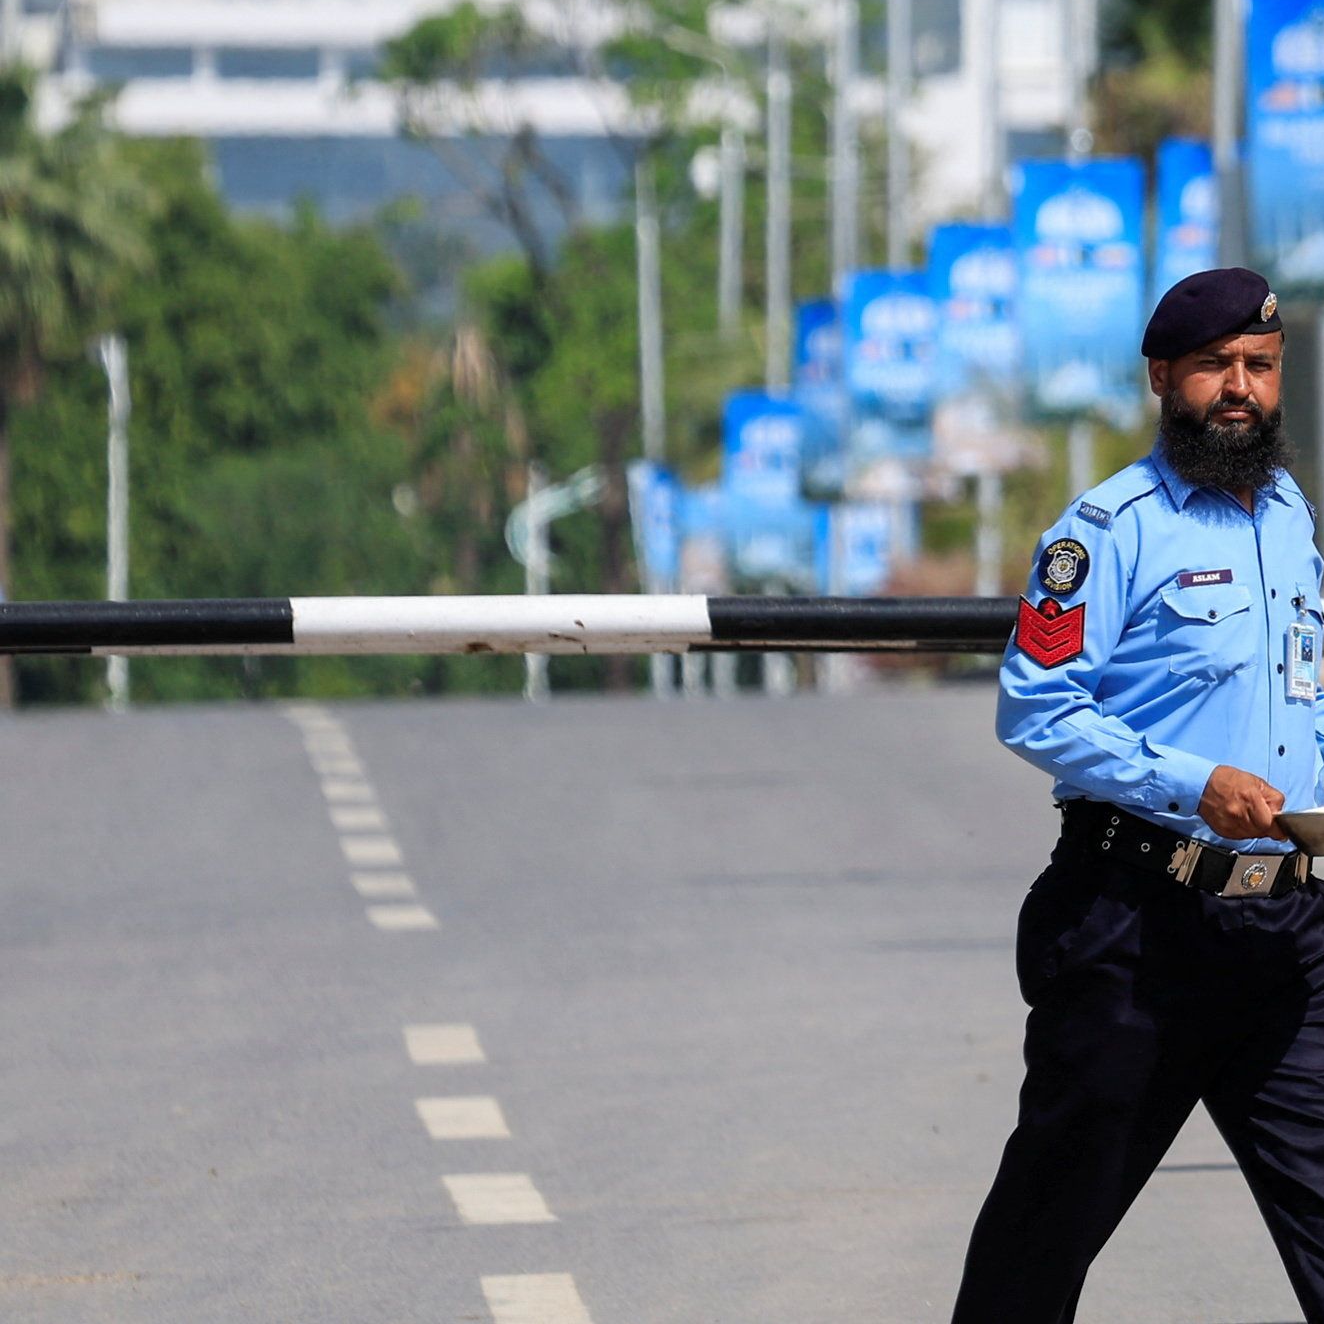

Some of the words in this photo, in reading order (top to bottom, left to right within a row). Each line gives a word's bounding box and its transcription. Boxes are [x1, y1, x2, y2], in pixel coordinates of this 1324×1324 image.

[1047, 540, 1086, 560] OPERATIONS
[1044, 577, 1073, 590] DIVISION
[1192, 573, 1221, 583] ASLAM
